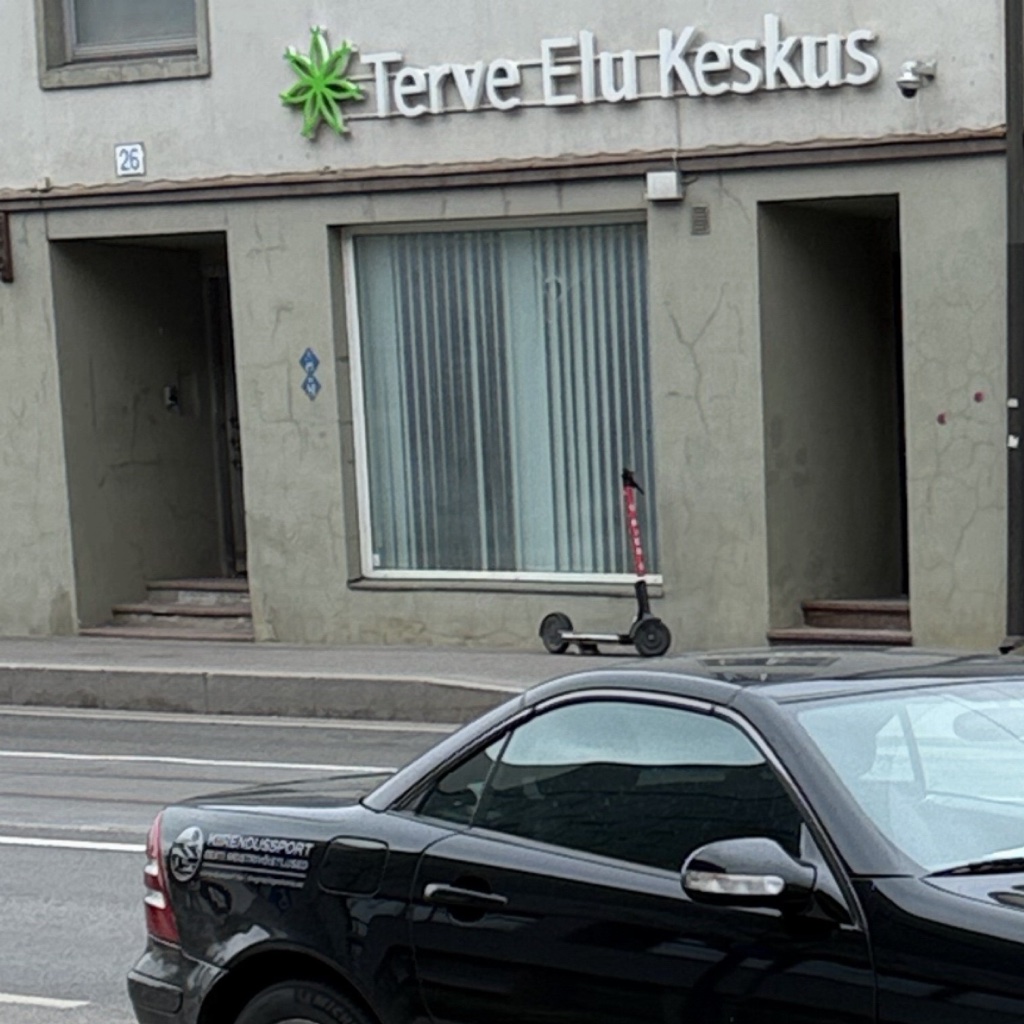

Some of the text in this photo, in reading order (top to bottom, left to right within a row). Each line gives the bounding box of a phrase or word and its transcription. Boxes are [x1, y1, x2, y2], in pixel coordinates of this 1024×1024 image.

[360, 13, 879, 117] Terve Elu Keskus
[119, 147, 140, 171] 26
